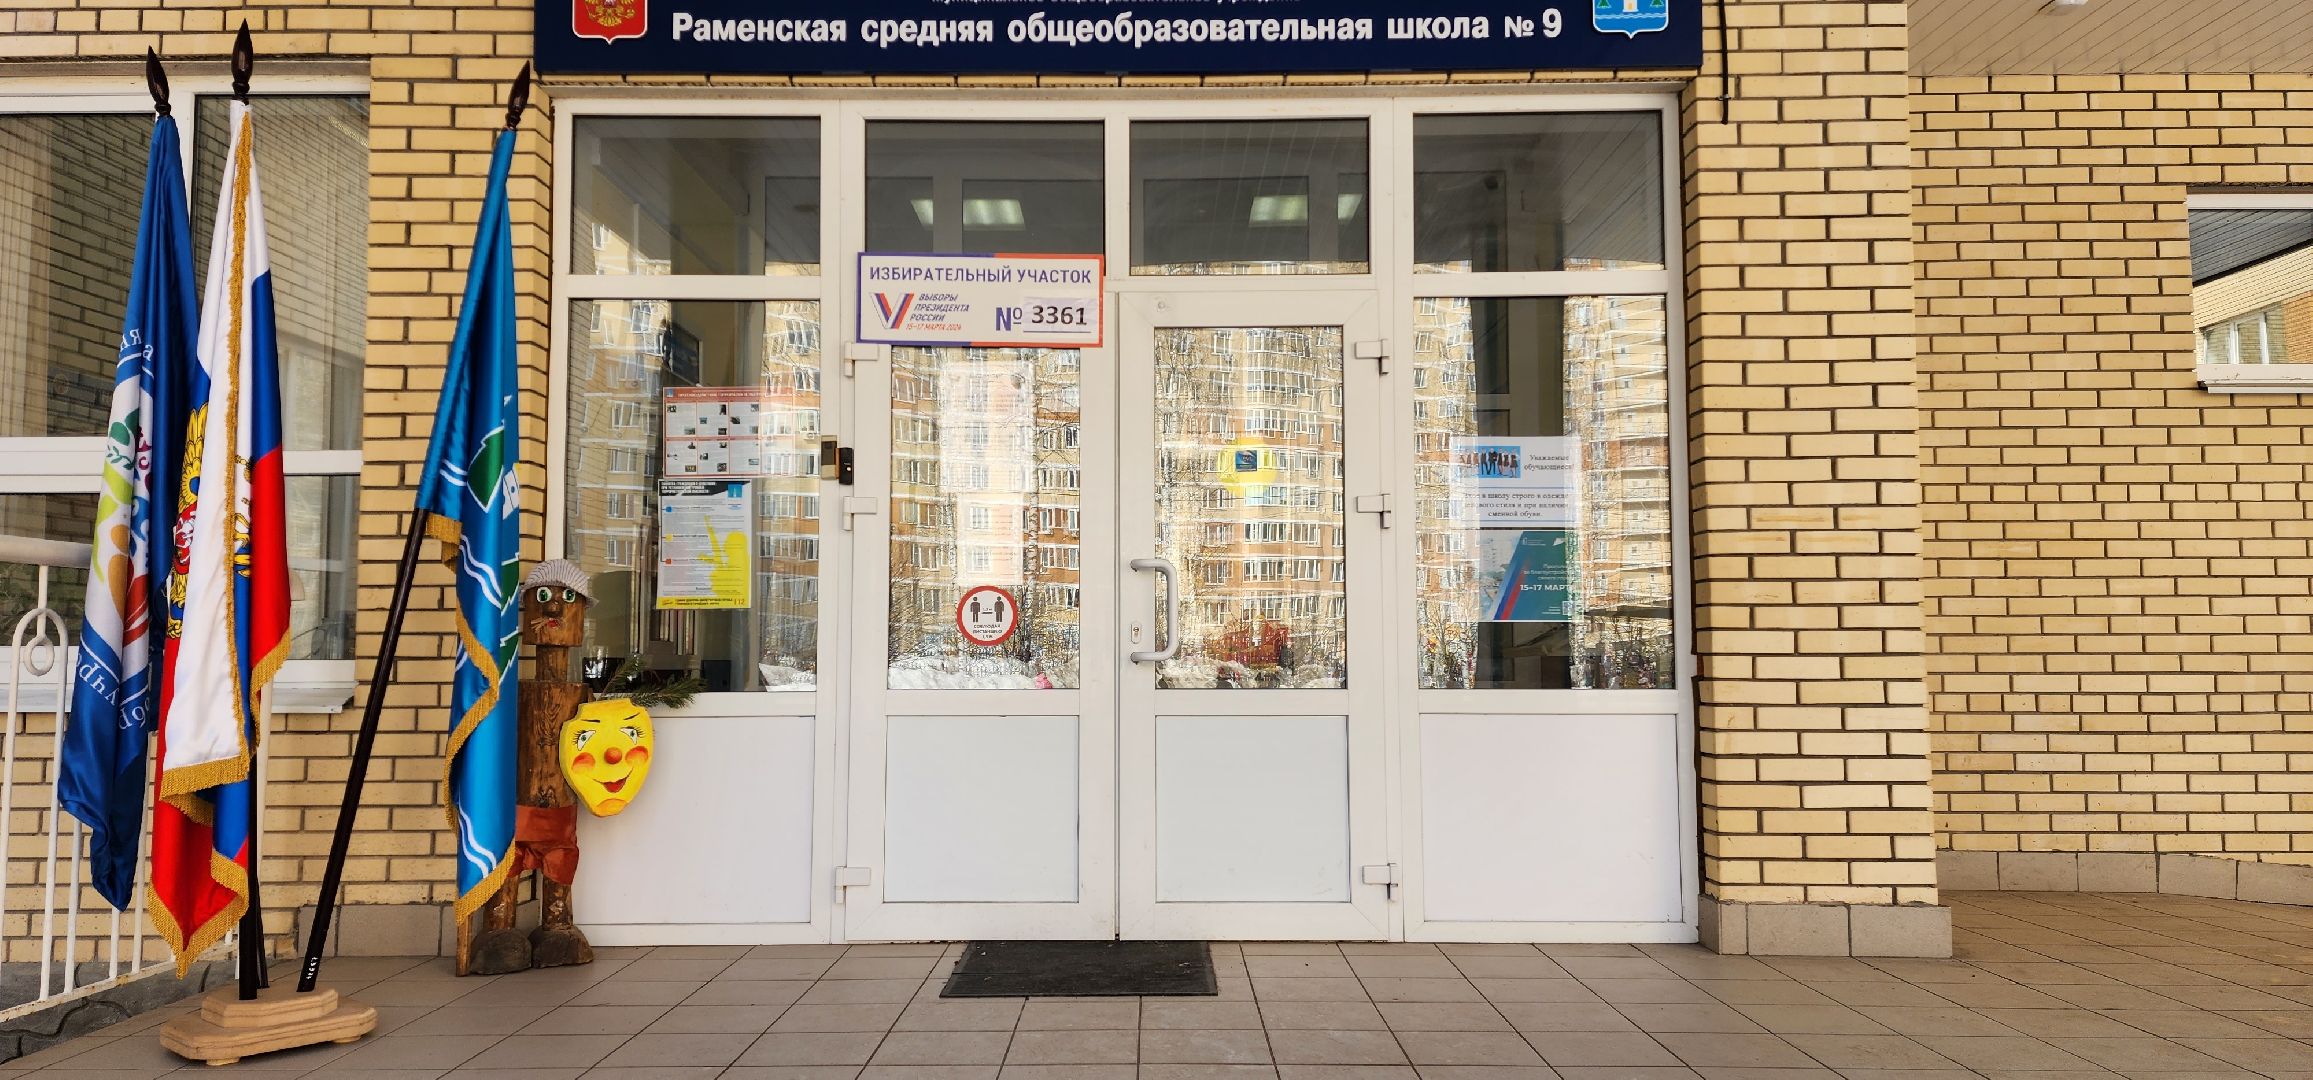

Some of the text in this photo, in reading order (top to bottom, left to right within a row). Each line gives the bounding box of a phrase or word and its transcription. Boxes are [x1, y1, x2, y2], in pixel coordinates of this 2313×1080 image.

[672, 7, 1562, 49] Раменская средняя общеобразовательная школа № 9
[869, 265, 1091, 284] ИЗБИРАТЕЛЬНЫЙ УЧАСТОК
[919, 293, 959, 301] ВЫБОРЫ
[914, 303, 970, 312] ПРЕЗИДЕНТА
[910, 313, 946, 321] РОССИИ
[995, 304, 1088, 332] № 3361
